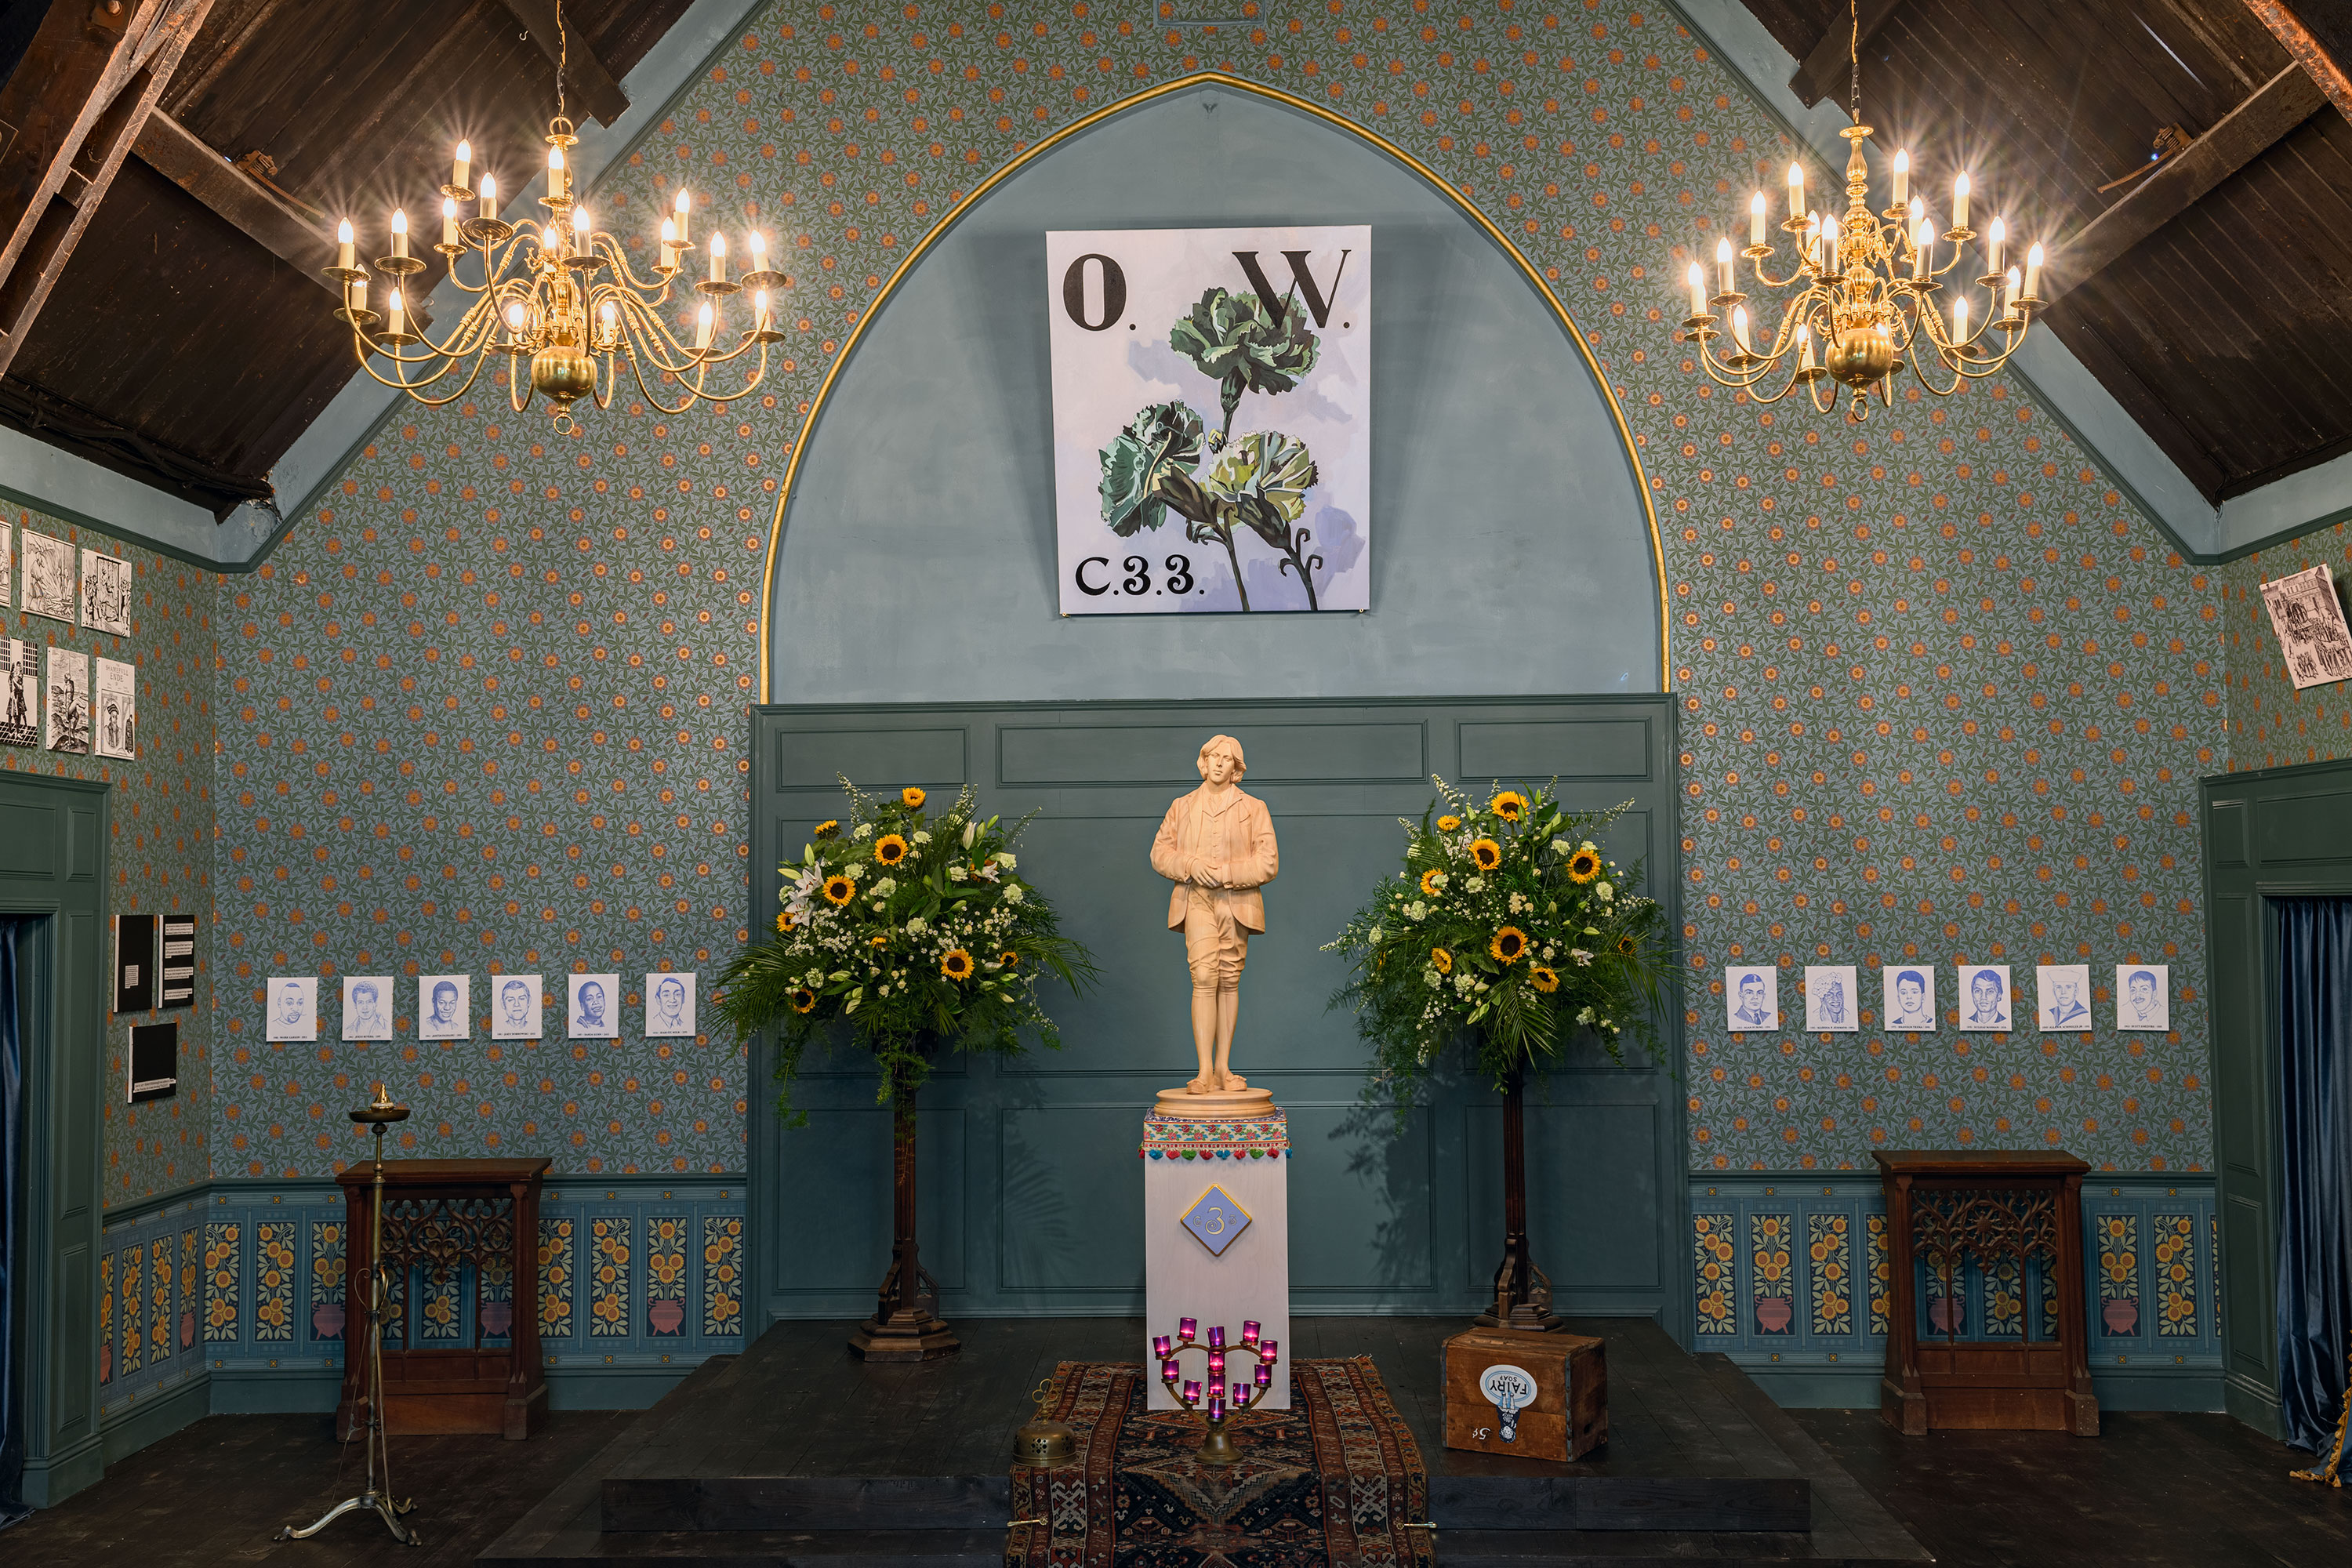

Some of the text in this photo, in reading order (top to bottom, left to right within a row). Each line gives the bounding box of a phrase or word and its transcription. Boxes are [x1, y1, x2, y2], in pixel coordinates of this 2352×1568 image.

[1062, 249, 1352, 332] O. W.
[110, 672, 124, 683] ENDE
[1490, 1380, 1527, 1395] FAIRY
